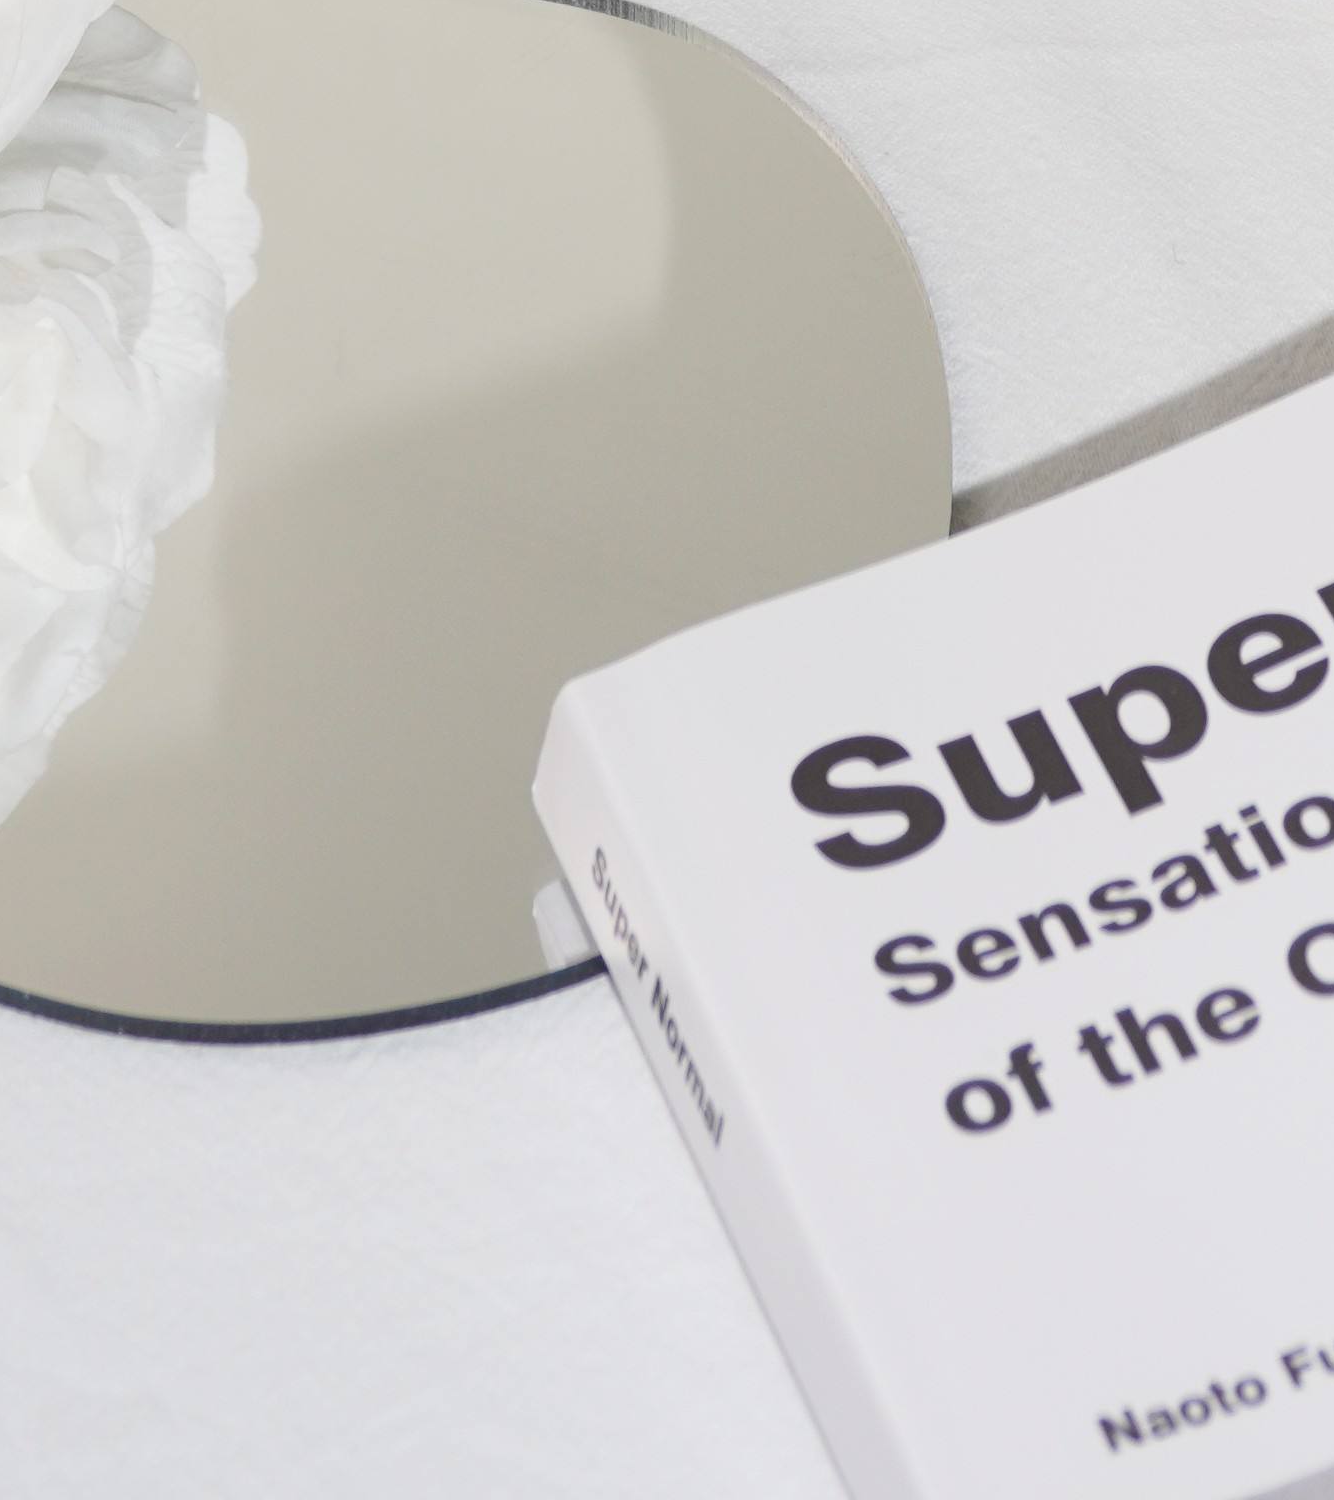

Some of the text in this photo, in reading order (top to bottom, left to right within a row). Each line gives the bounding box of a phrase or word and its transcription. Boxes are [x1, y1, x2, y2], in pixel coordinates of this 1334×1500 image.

[592, 846, 725, 1149] Super Normal
[945, 1043, 1051, 1133] of
[1079, 988, 1258, 1087] the
[1099, 1379, 1266, 1450] Naoto
